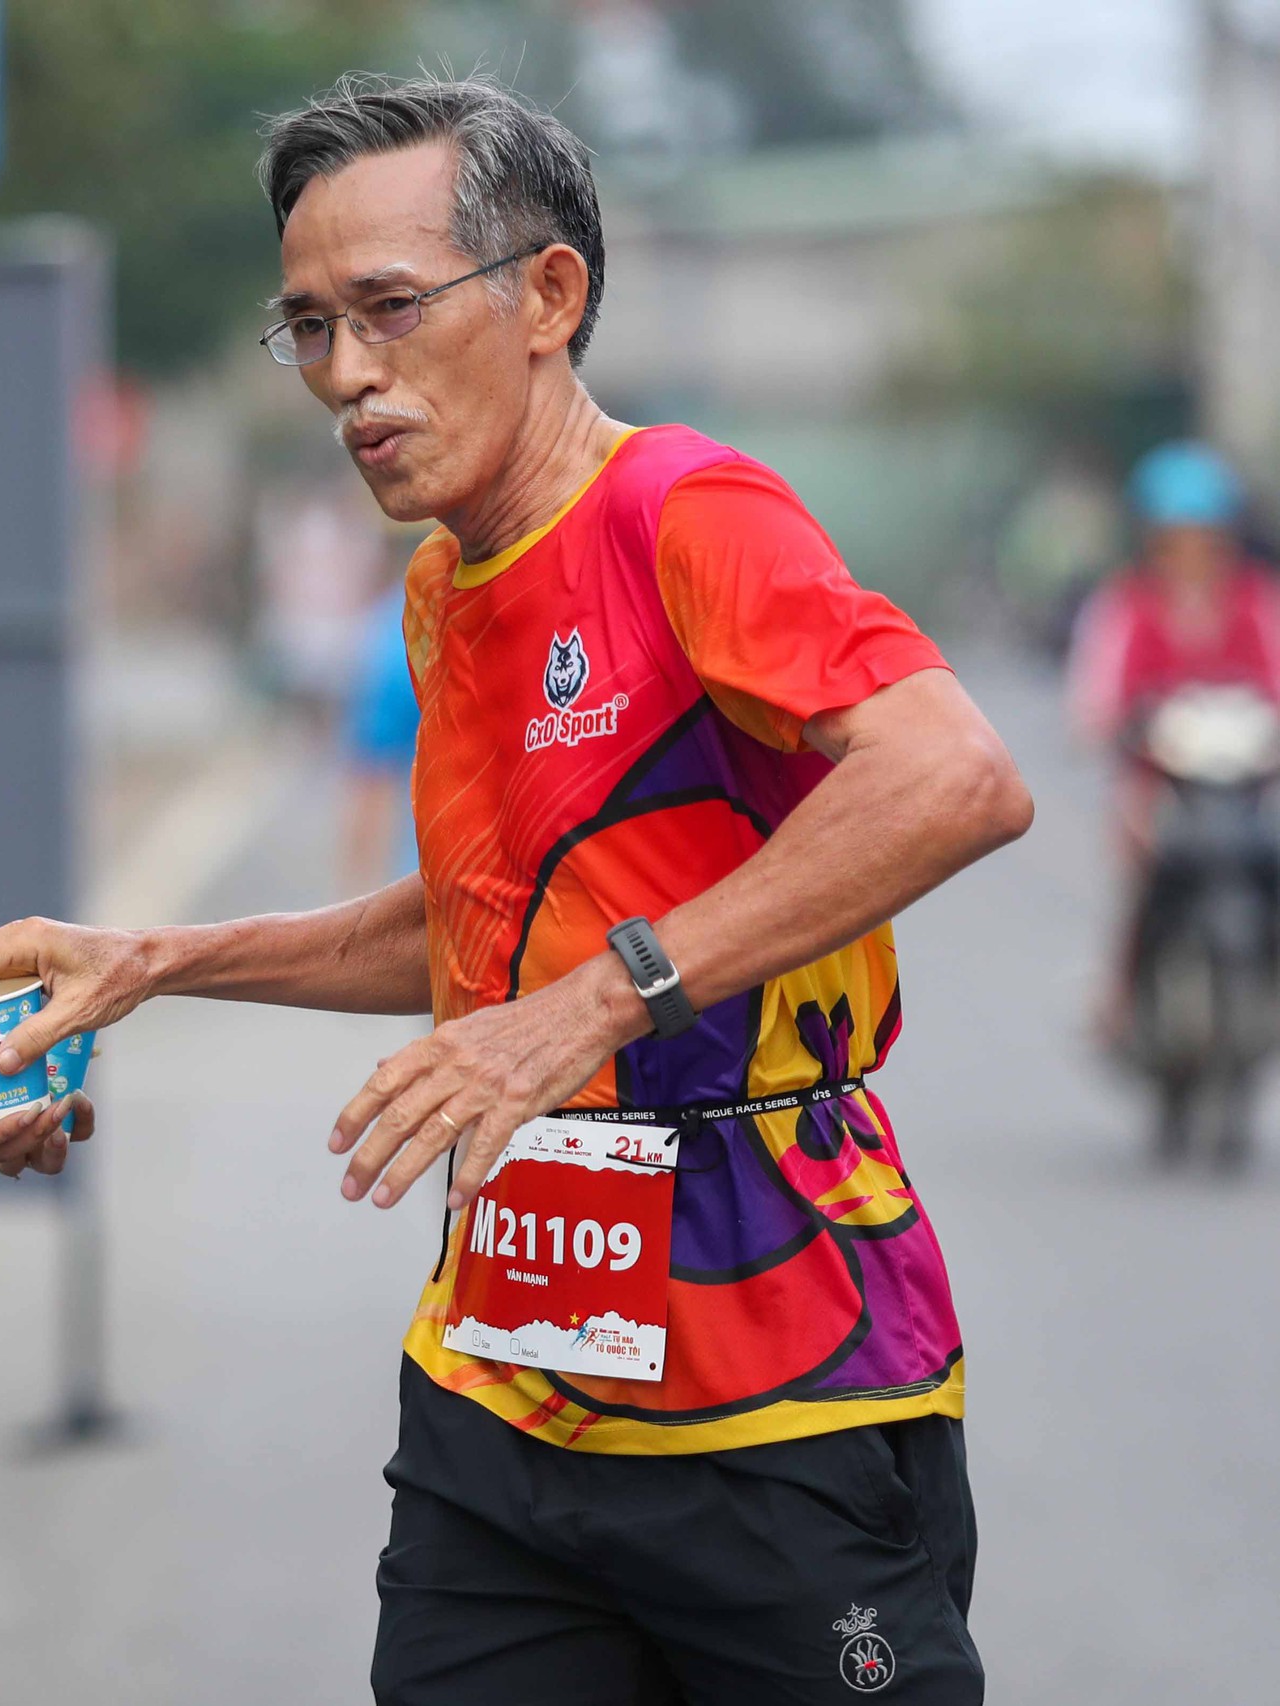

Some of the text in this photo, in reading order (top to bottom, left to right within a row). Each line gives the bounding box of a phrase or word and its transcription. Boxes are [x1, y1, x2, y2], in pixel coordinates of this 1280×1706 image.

[812, 1089, 831, 1101] URS
[736, 1102, 763, 1114] RACE
[765, 1096, 798, 1110] SERIES
[561, 1111, 656, 1121] UNIQUE RACE SERIES
[615, 1135, 663, 1164] 21 KM
[470, 1195, 642, 1271] M21109
[522, 1274, 549, 1287] MẠNH
[481, 1340, 491, 1350] Size
[521, 1348, 539, 1359] Medal
